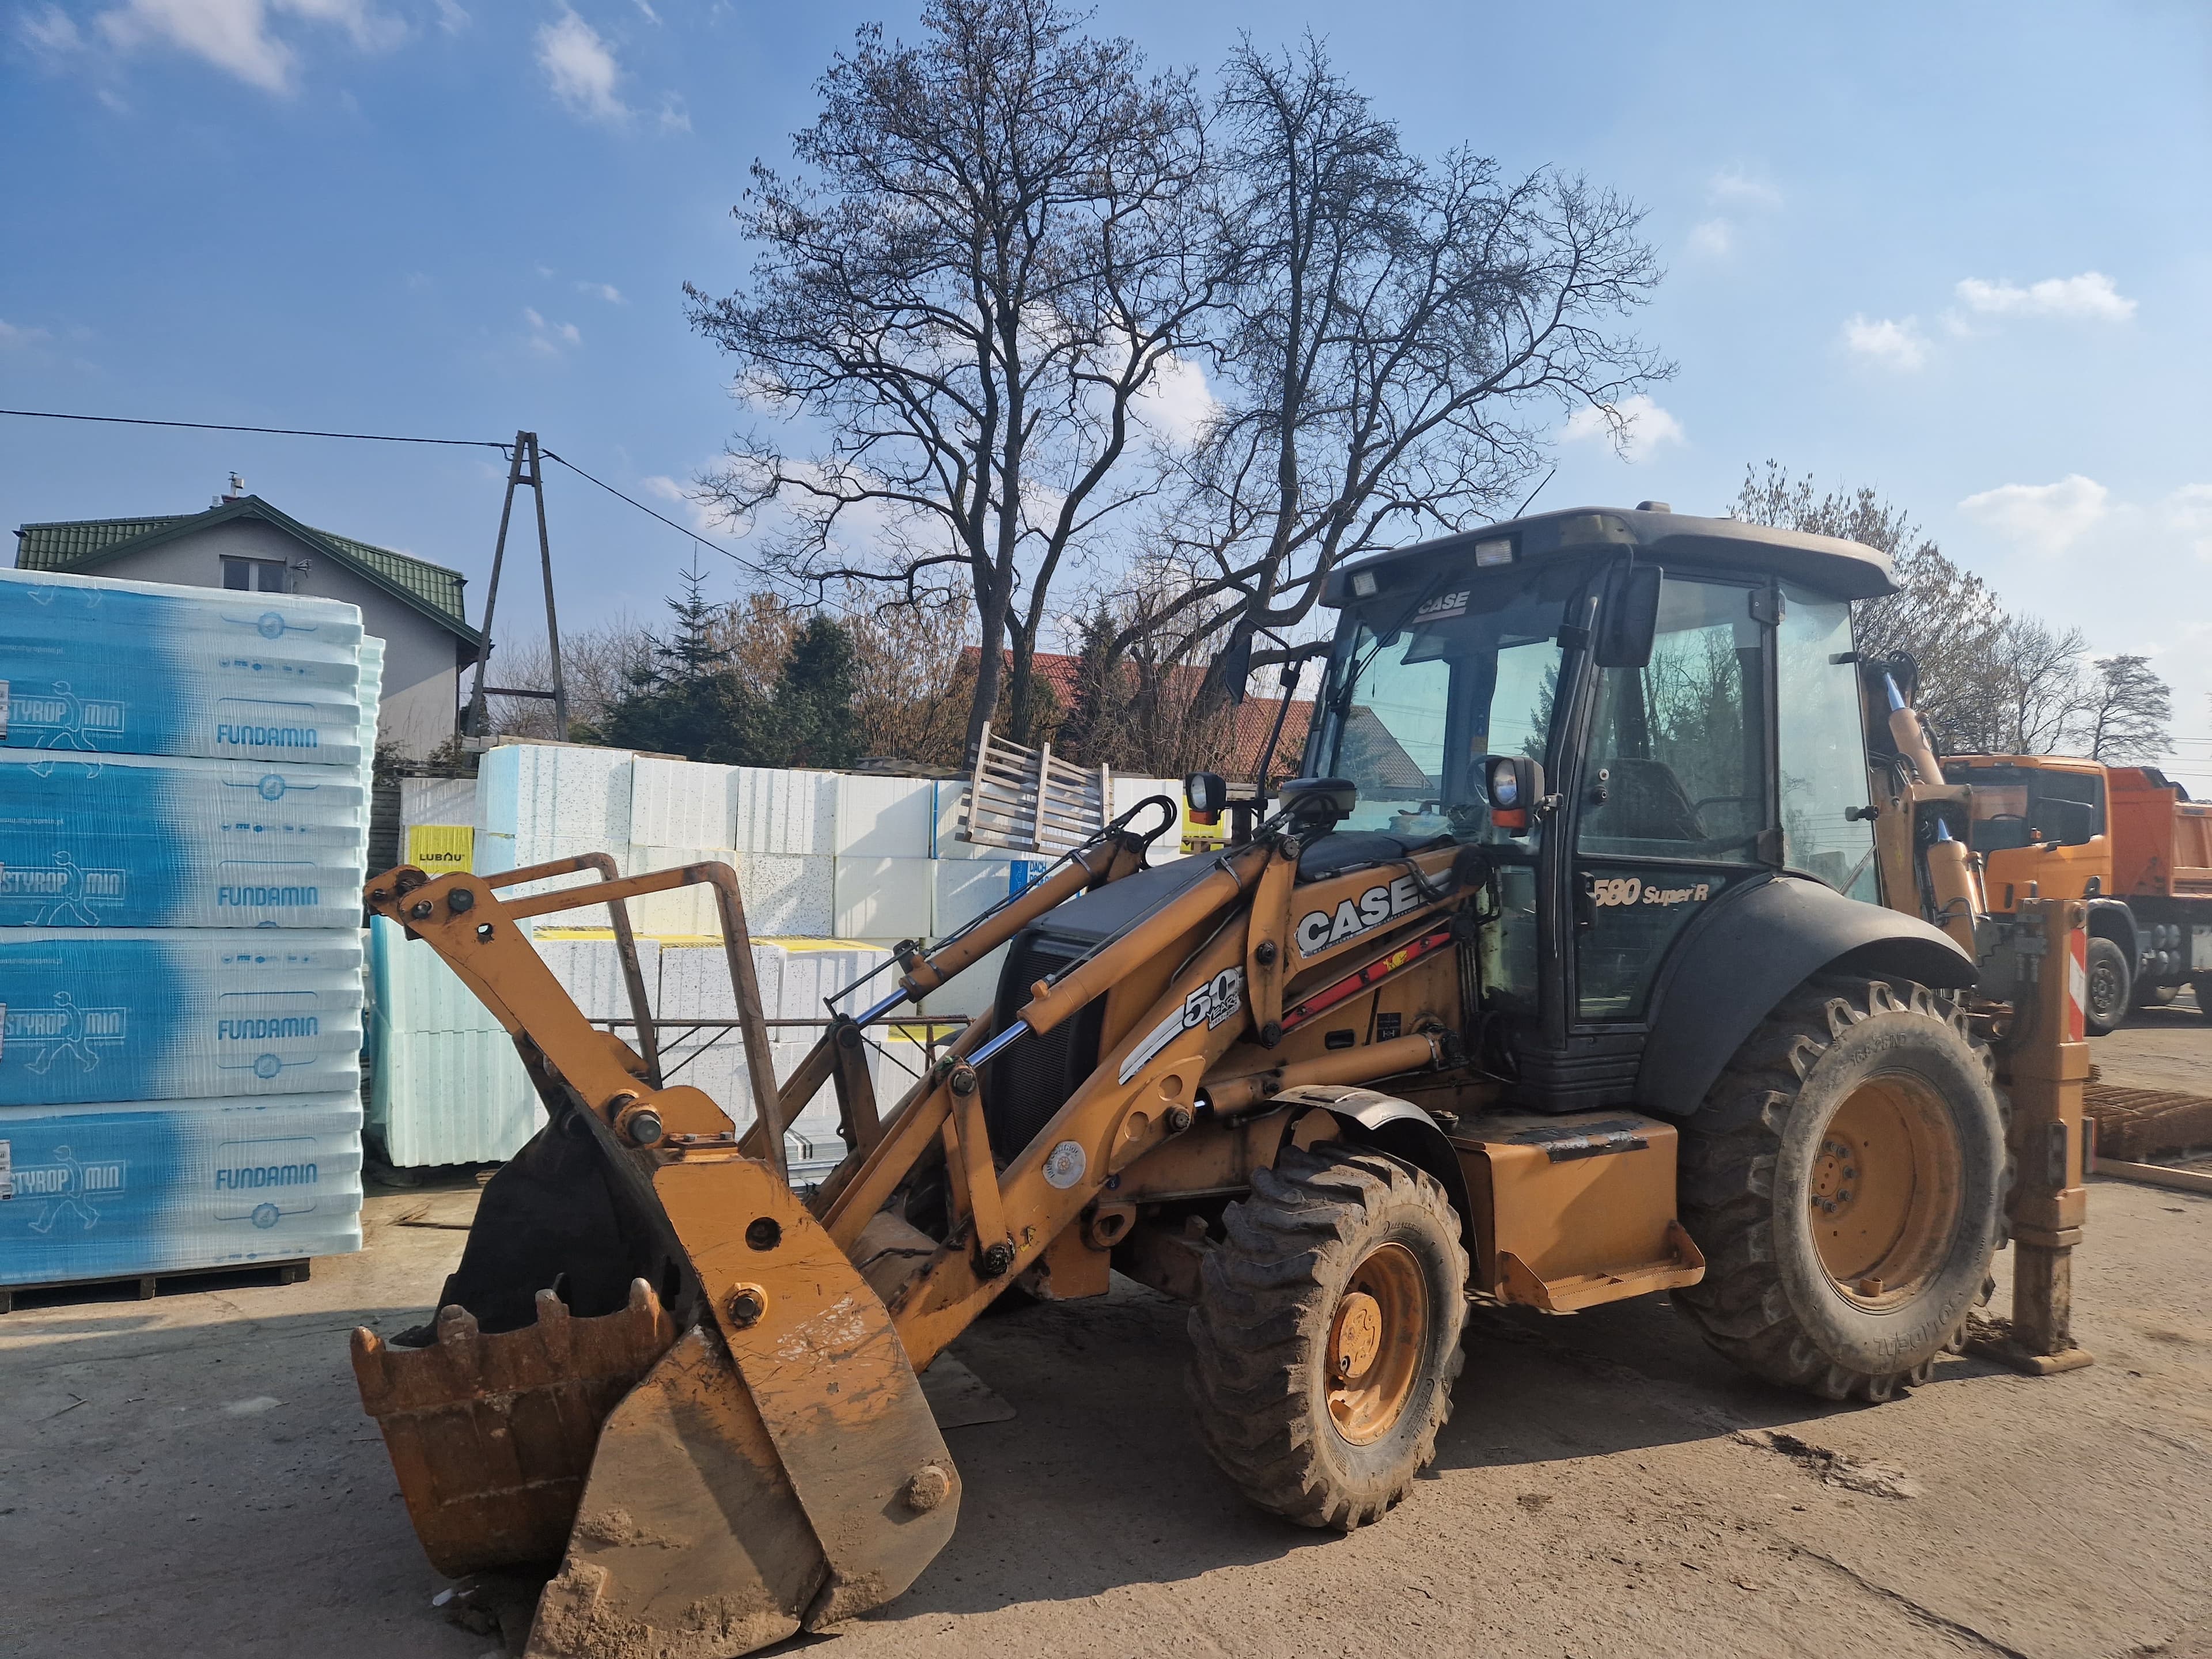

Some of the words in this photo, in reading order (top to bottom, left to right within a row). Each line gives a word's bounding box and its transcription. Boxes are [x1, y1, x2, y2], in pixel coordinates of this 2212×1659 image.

[1418, 590, 1470, 613] CASE
[217, 724, 317, 748] FUNDAMIN
[1030, 861, 1047, 873] DACH
[218, 887, 318, 906] FUNDAMIN
[1594, 877, 1641, 907] 580
[1643, 886, 1694, 906] Super
[1694, 884, 1709, 900] R
[1297, 874, 1419, 951] CASE
[1182, 968, 1238, 1028] 50
[1206, 995, 1238, 1020] YEARS
[218, 1017, 318, 1040] FUNDAMIN
[216, 1163, 317, 1190] FUNDAMIN
